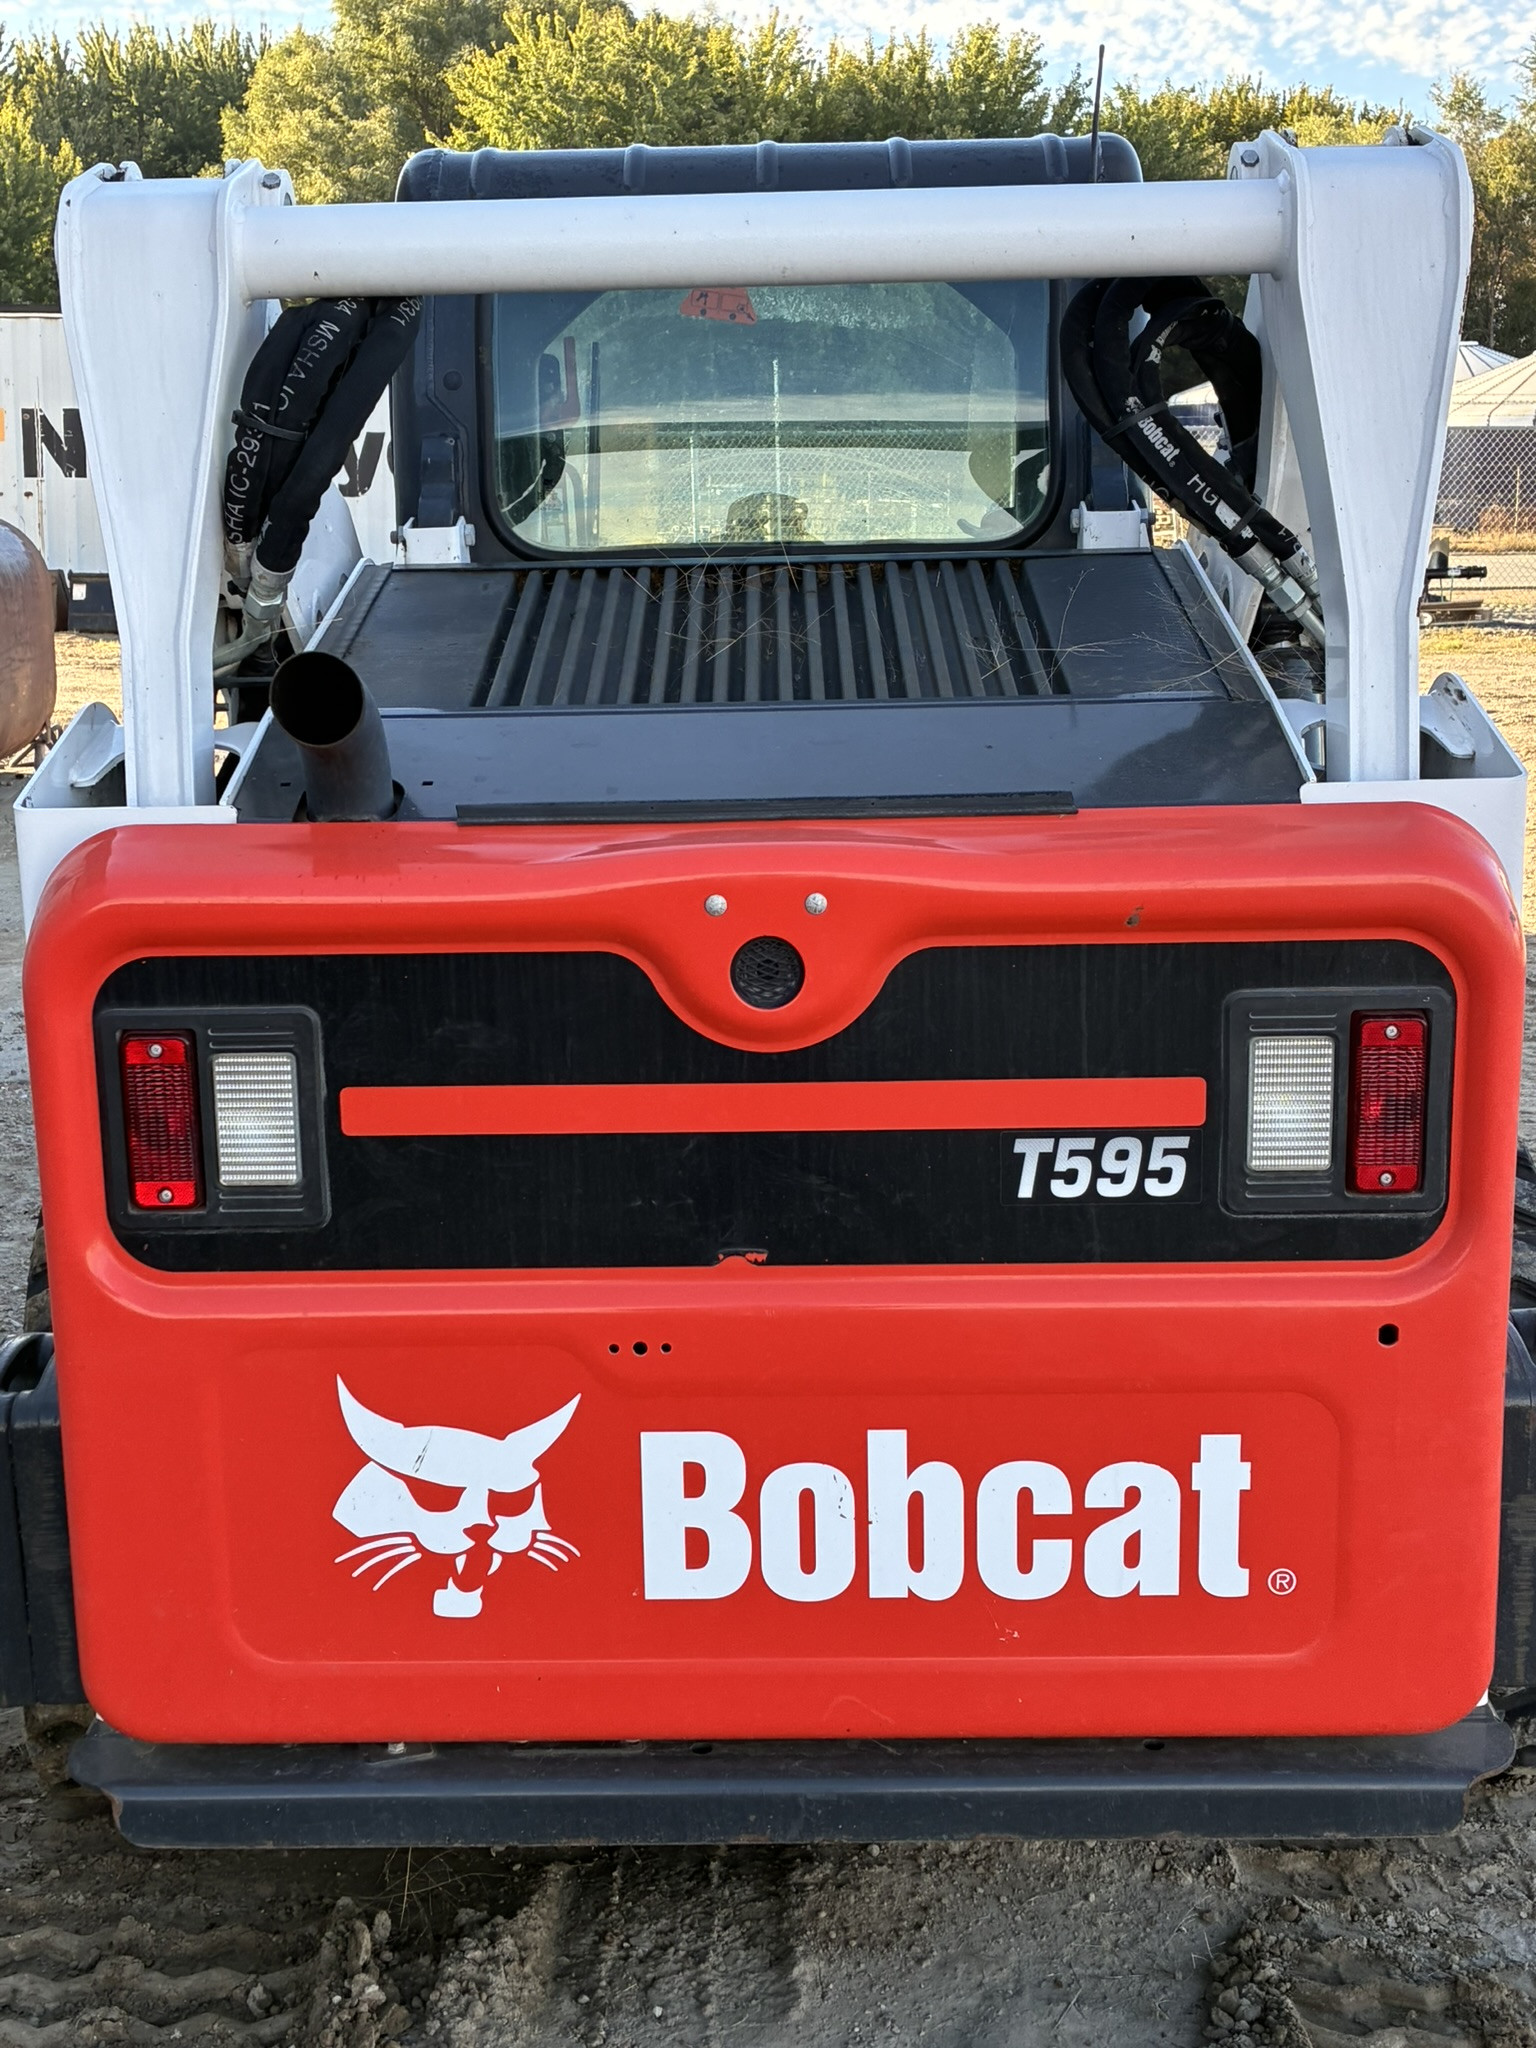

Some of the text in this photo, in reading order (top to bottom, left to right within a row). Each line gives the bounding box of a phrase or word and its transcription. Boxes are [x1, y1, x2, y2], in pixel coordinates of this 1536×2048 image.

[287, 320, 340, 379] MSHA
[1137, 416, 1180, 462] Bobcat
[1186, 473, 1219, 506] HG
[225, 502, 245, 545] SHA
[1013, 1136, 1190, 1198] T595
[640, 1429, 1251, 1601] Bobcat
